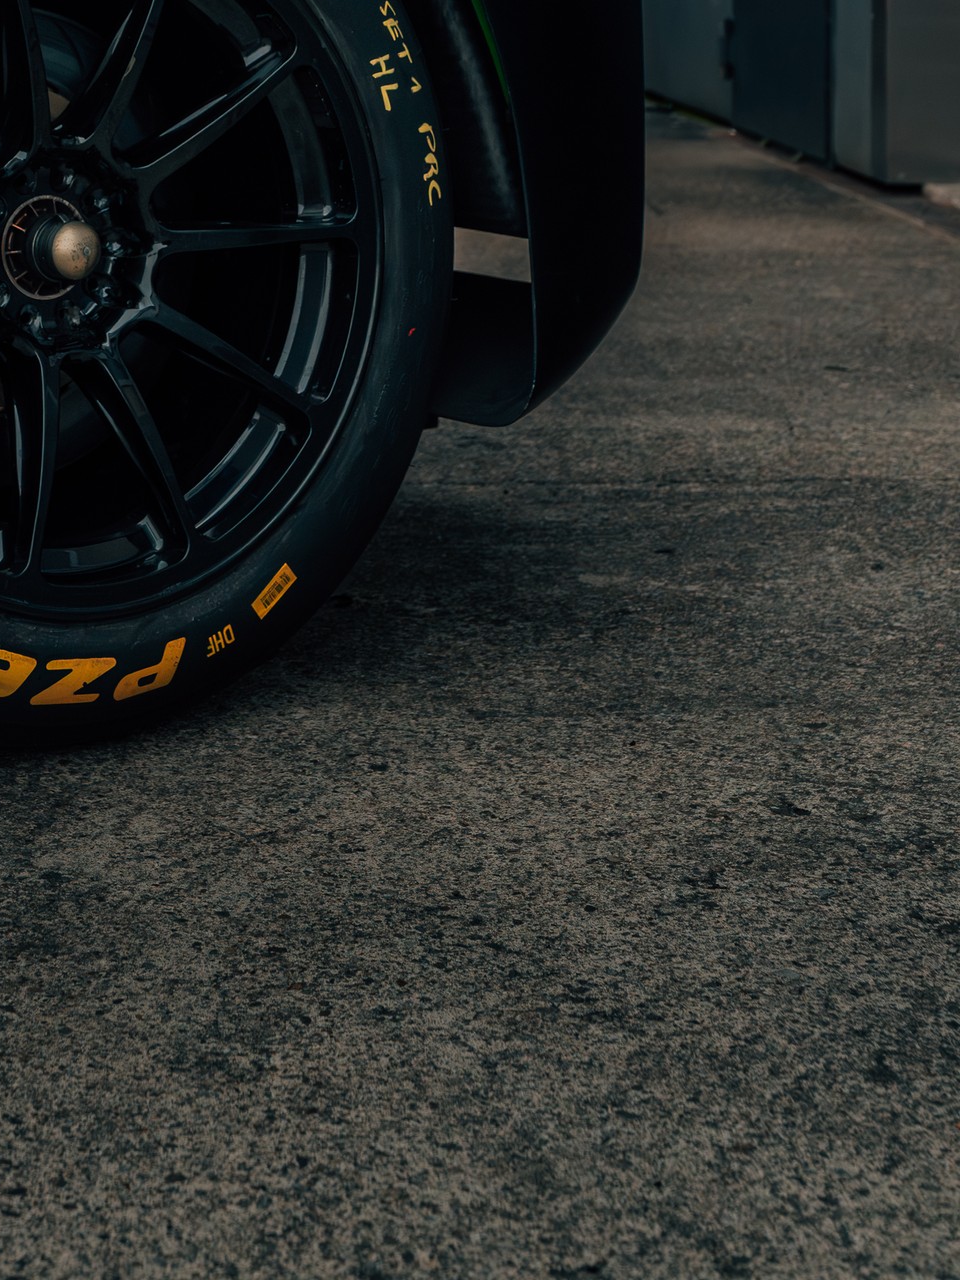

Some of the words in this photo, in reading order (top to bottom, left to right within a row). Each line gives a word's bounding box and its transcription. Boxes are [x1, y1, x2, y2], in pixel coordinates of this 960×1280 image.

[379, 0, 413, 63] SET
[369, 53, 399, 112] HL
[206, 624, 236, 658] DHF
